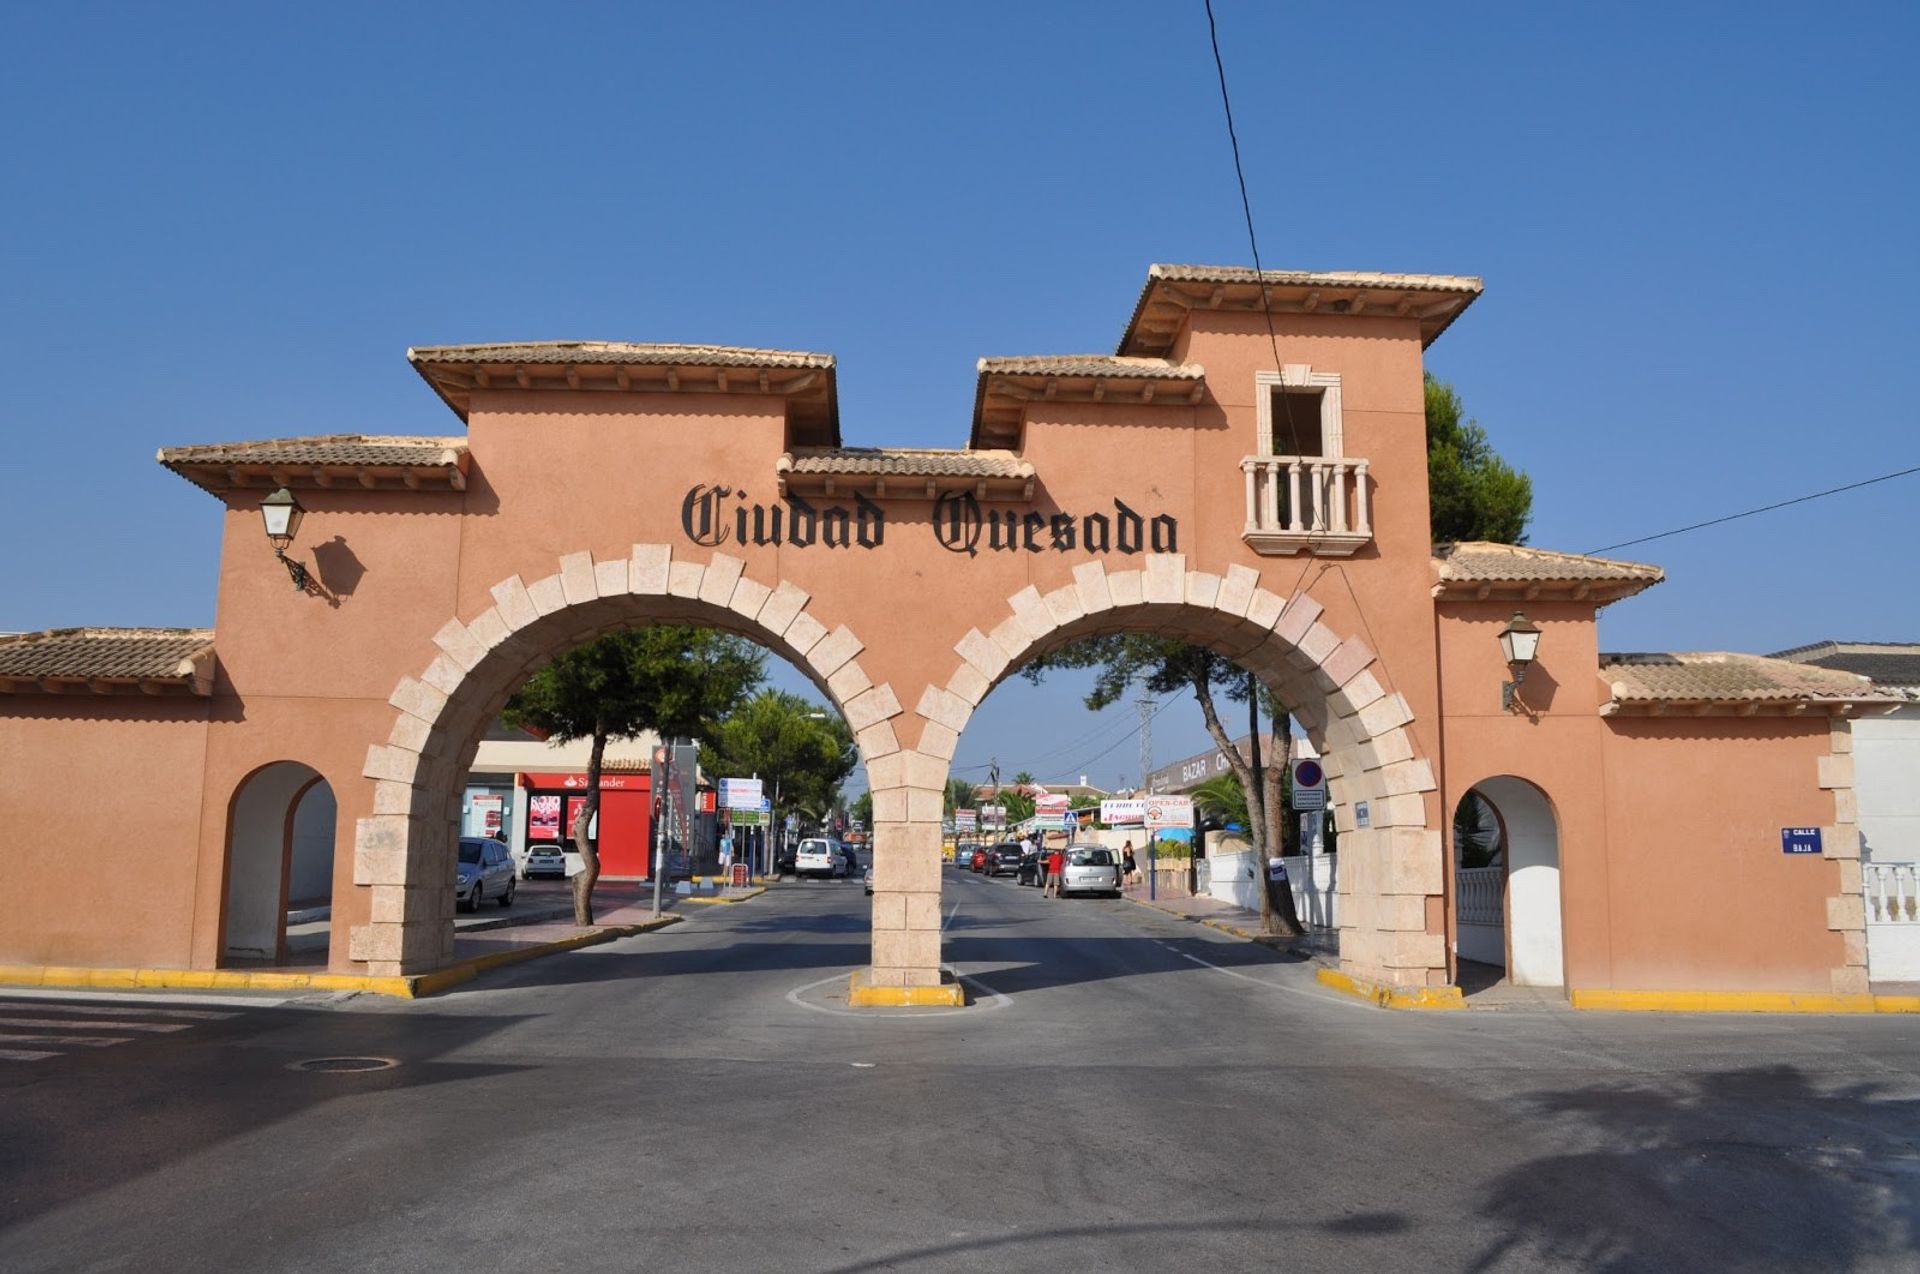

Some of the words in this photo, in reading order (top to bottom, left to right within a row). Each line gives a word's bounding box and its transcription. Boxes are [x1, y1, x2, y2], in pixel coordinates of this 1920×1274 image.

[682, 484, 885, 549] Ciudad
[932, 490, 1178, 558] Quesada
[1183, 759, 1206, 782] BAZAR
[578, 777, 625, 788] Saander
[1792, 843, 1812, 852] BAJA
